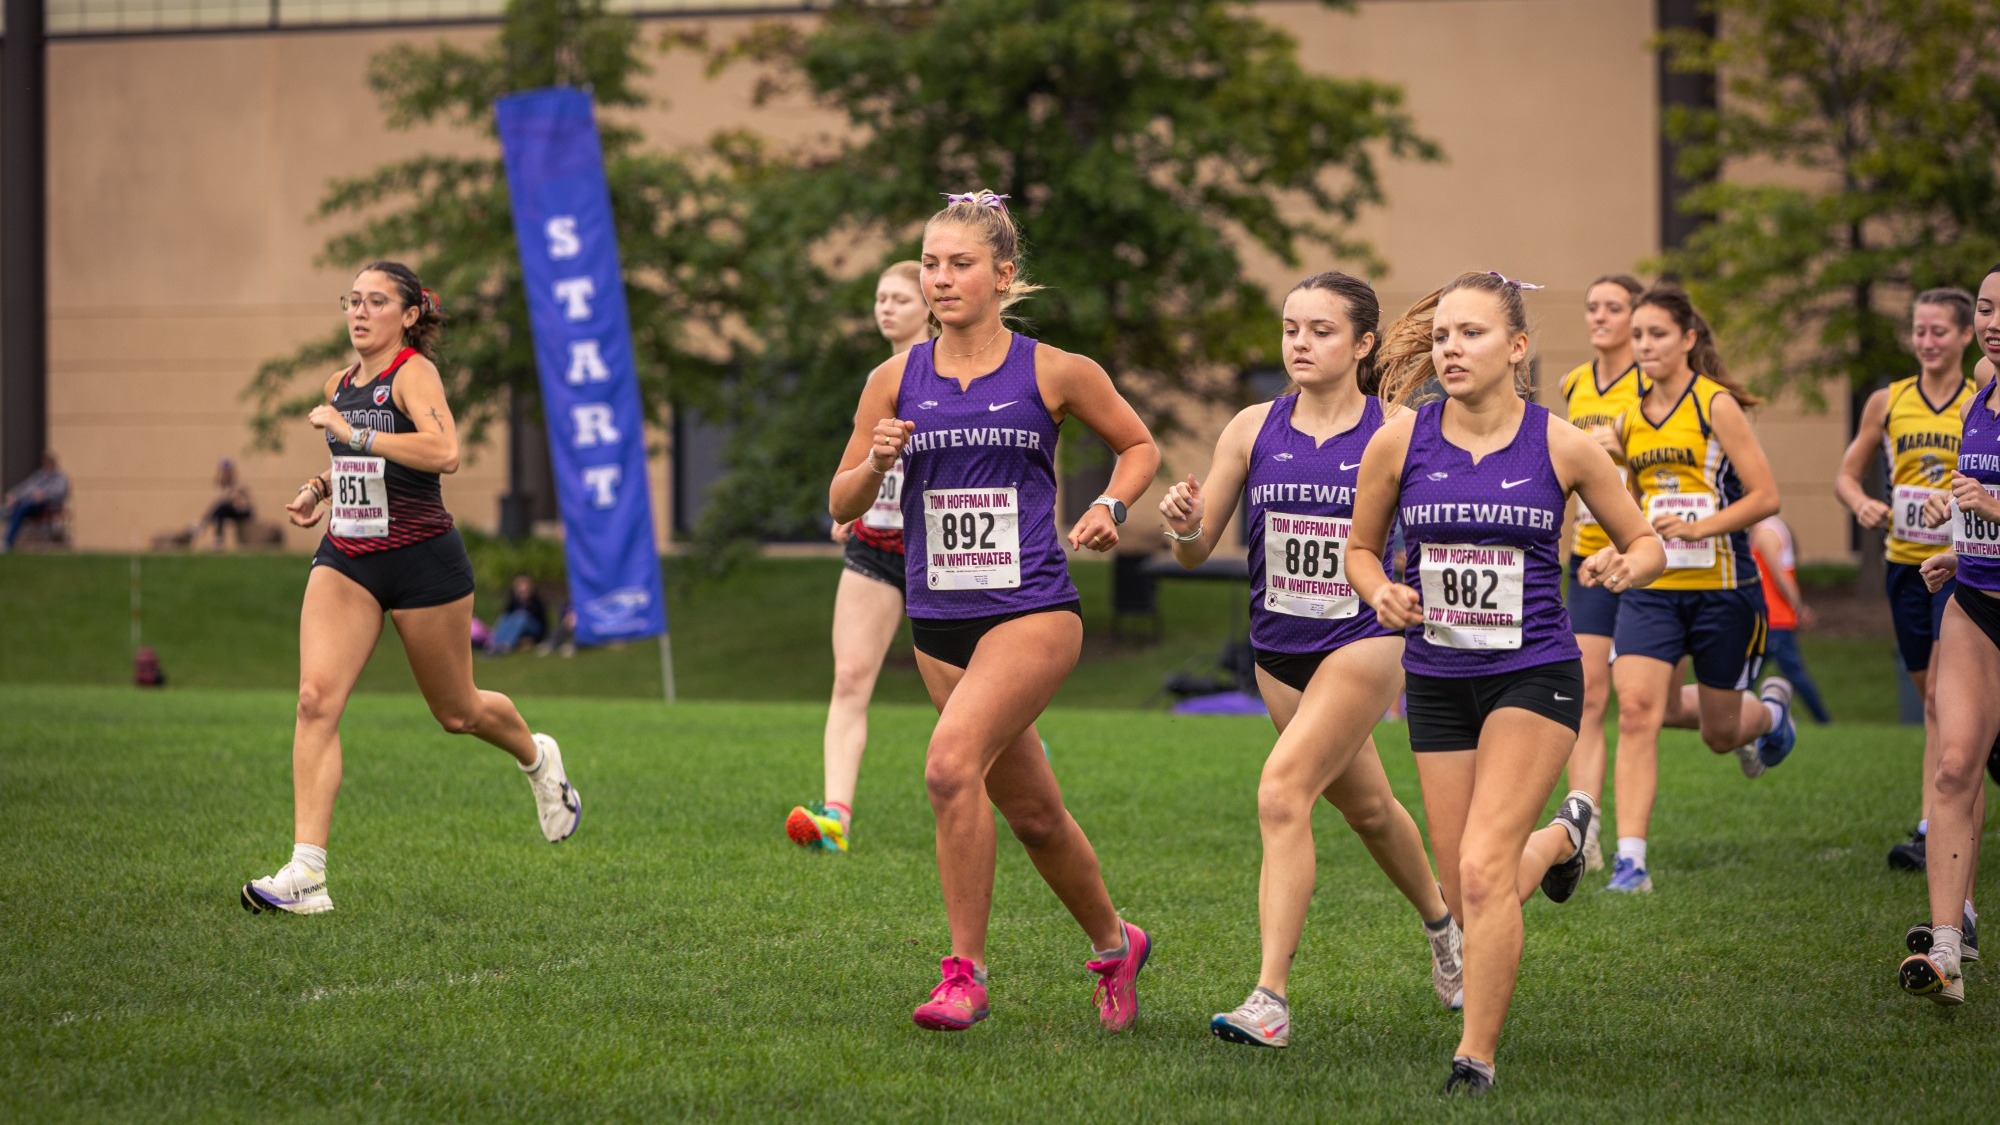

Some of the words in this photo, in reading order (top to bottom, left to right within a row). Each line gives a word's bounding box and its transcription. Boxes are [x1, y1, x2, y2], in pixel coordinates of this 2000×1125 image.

[545, 216, 621, 508] START
[903, 427, 1041, 456] WHITEWATER
[340, 475, 371, 506] 851
[880, 475, 896, 500] 50
[1251, 483, 1357, 506] WHITEWA
[342, 506, 383, 519] WHITEWATER
[929, 494, 945, 510] TOM
[947, 493, 990, 510] HOFFMAN
[992, 492, 1011, 508] INV.
[1271, 517, 1290, 534] TOM
[1292, 519, 1337, 538] HOFFMAN
[1403, 503, 1554, 531] WHITEWATER
[1906, 502, 1926, 528] 86
[941, 511, 997, 551] 892
[932, 553, 945, 567] UW
[947, 551, 1012, 567] WHITEWATER
[1285, 537, 1340, 579] 885
[1428, 548, 1447, 563] TOM
[1449, 548, 1495, 566] HOFFMAN
[1497, 550, 1516, 566] INV.
[1272, 574, 1286, 589] UW
[1288, 577, 1352, 597] WHITEWATER
[1441, 567, 1499, 610] 882
[1428, 607, 1444, 621] UW
[1446, 609, 1514, 626] WHITEWATER
